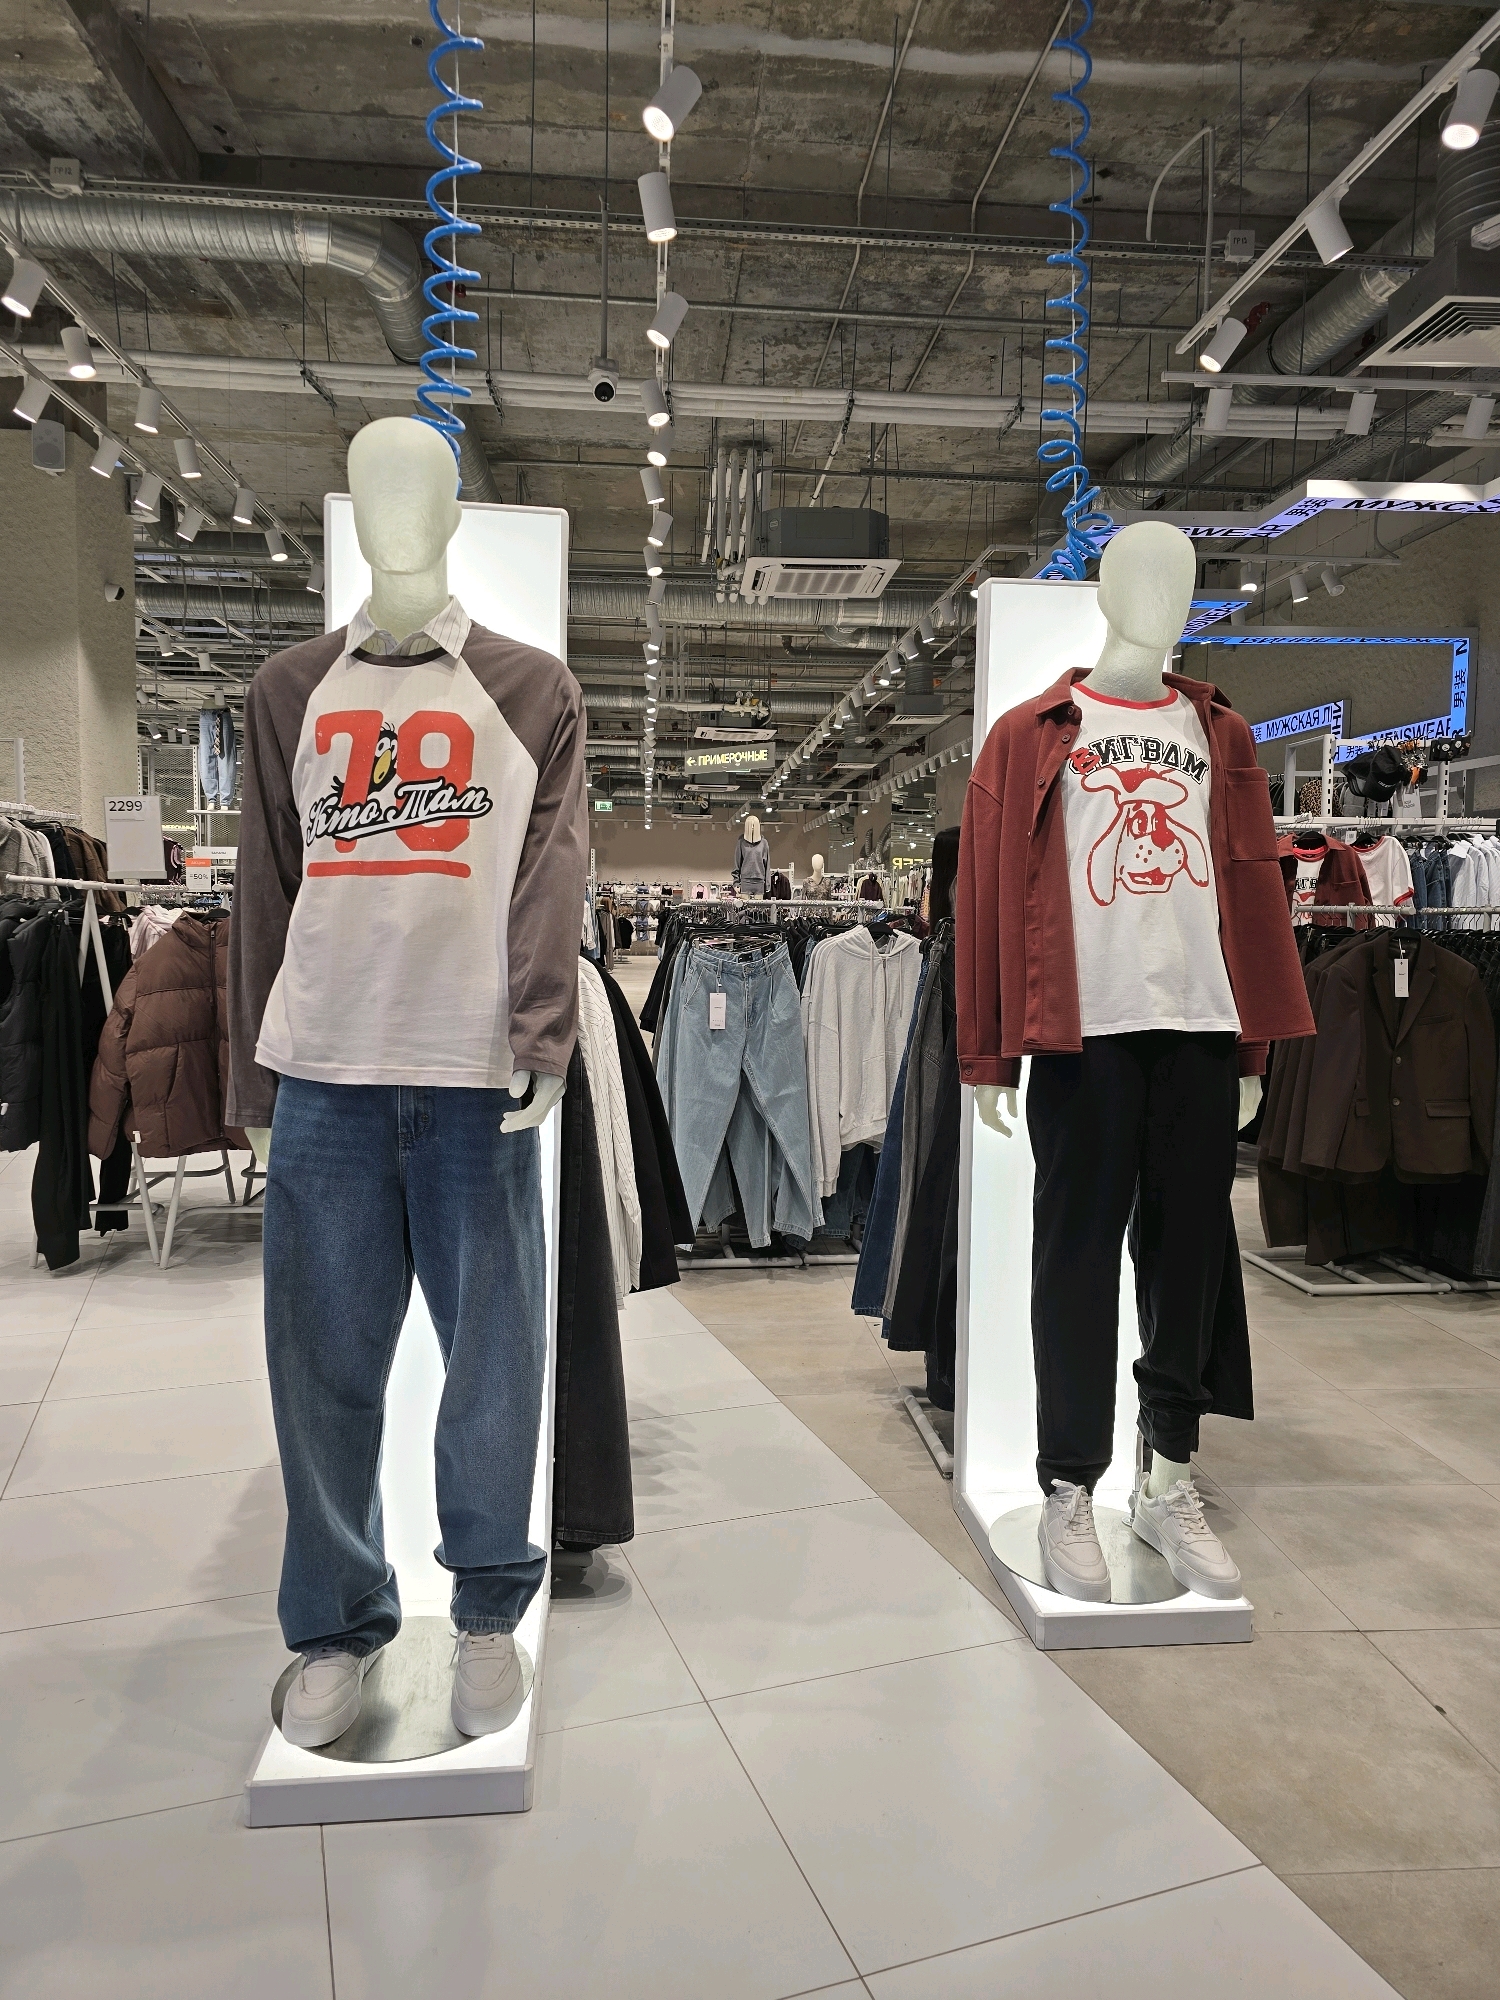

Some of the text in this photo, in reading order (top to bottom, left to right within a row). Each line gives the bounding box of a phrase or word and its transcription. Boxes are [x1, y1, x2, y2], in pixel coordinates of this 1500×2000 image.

[1342, 499, 1500, 513] МУЖСК
[1266, 709, 1320, 739] МУЖСКАЯ
[698, 750, 768, 766] ПРИМЕРОЧНЫЕ
[315, 710, 475, 853] 78
[108, 800, 143, 812] 2299
